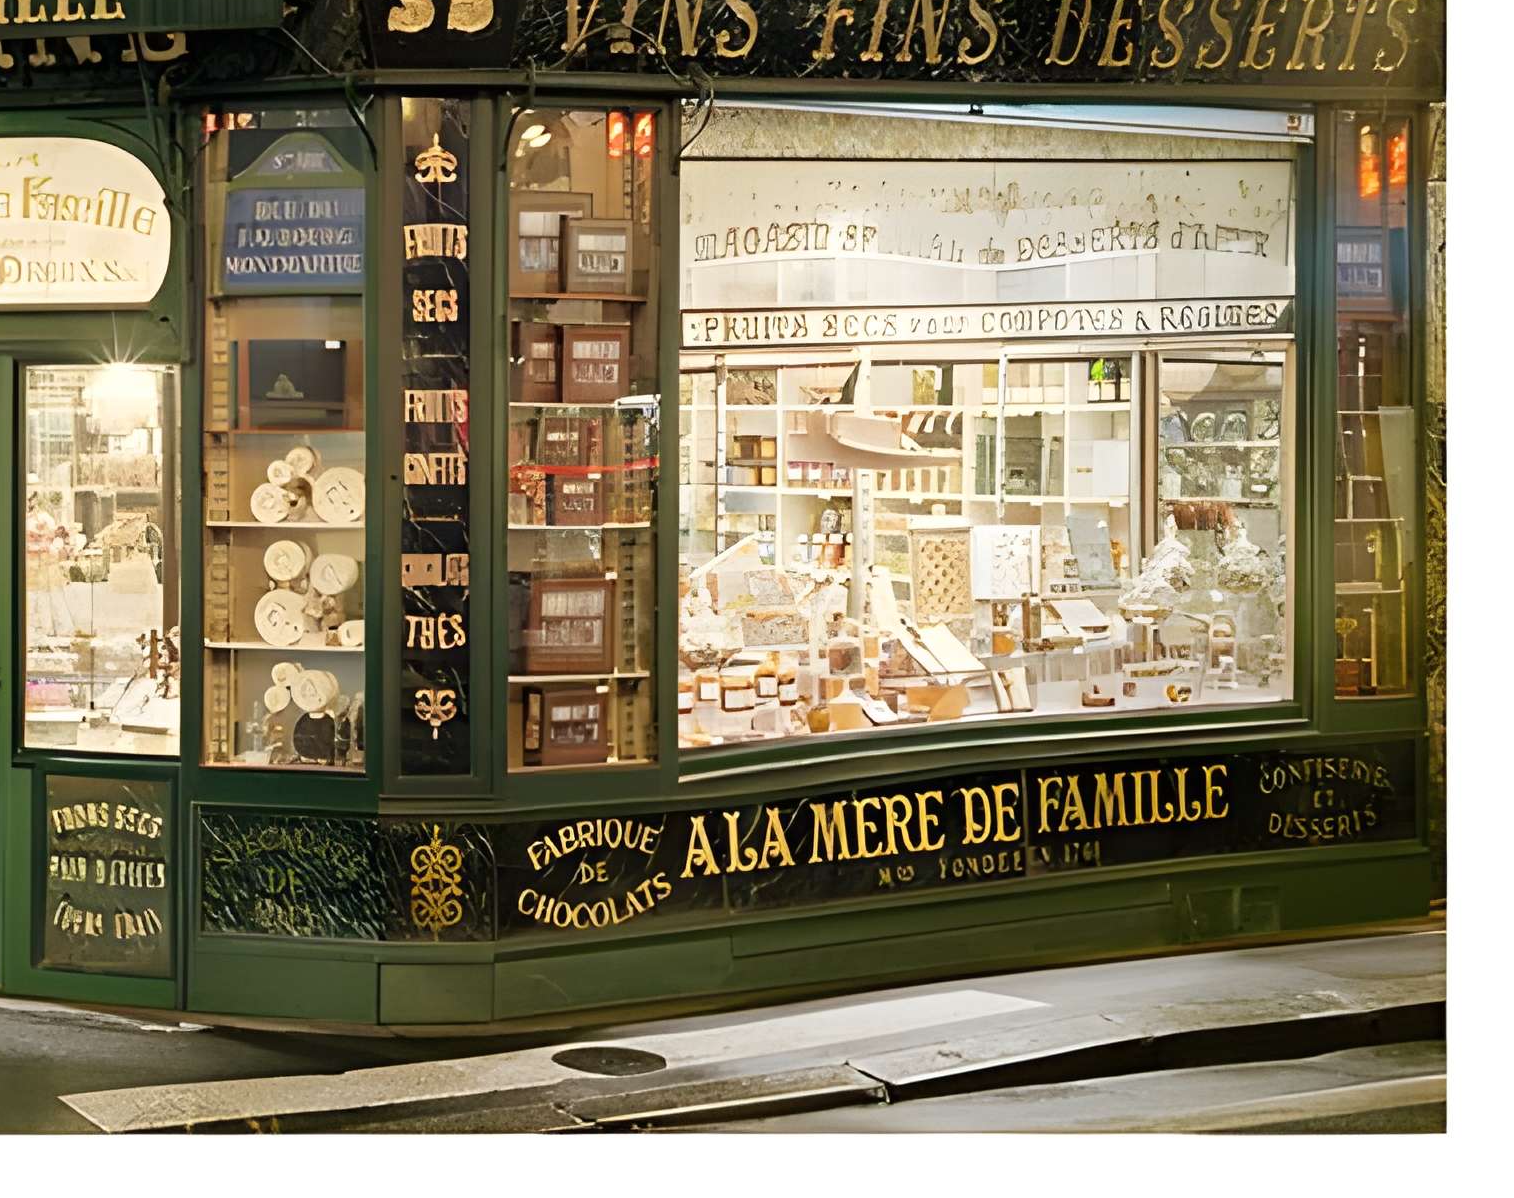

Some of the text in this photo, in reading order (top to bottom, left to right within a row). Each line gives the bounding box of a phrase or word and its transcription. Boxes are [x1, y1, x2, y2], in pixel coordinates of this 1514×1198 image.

[808, 790, 946, 865] MERE
[961, 782, 1021, 845] DE
[1037, 764, 1230, 833] FAMILLE
[527, 818, 665, 871] FABRIQUE
[579, 860, 609, 885] DE
[518, 872, 672, 929] CHOCOLATS
